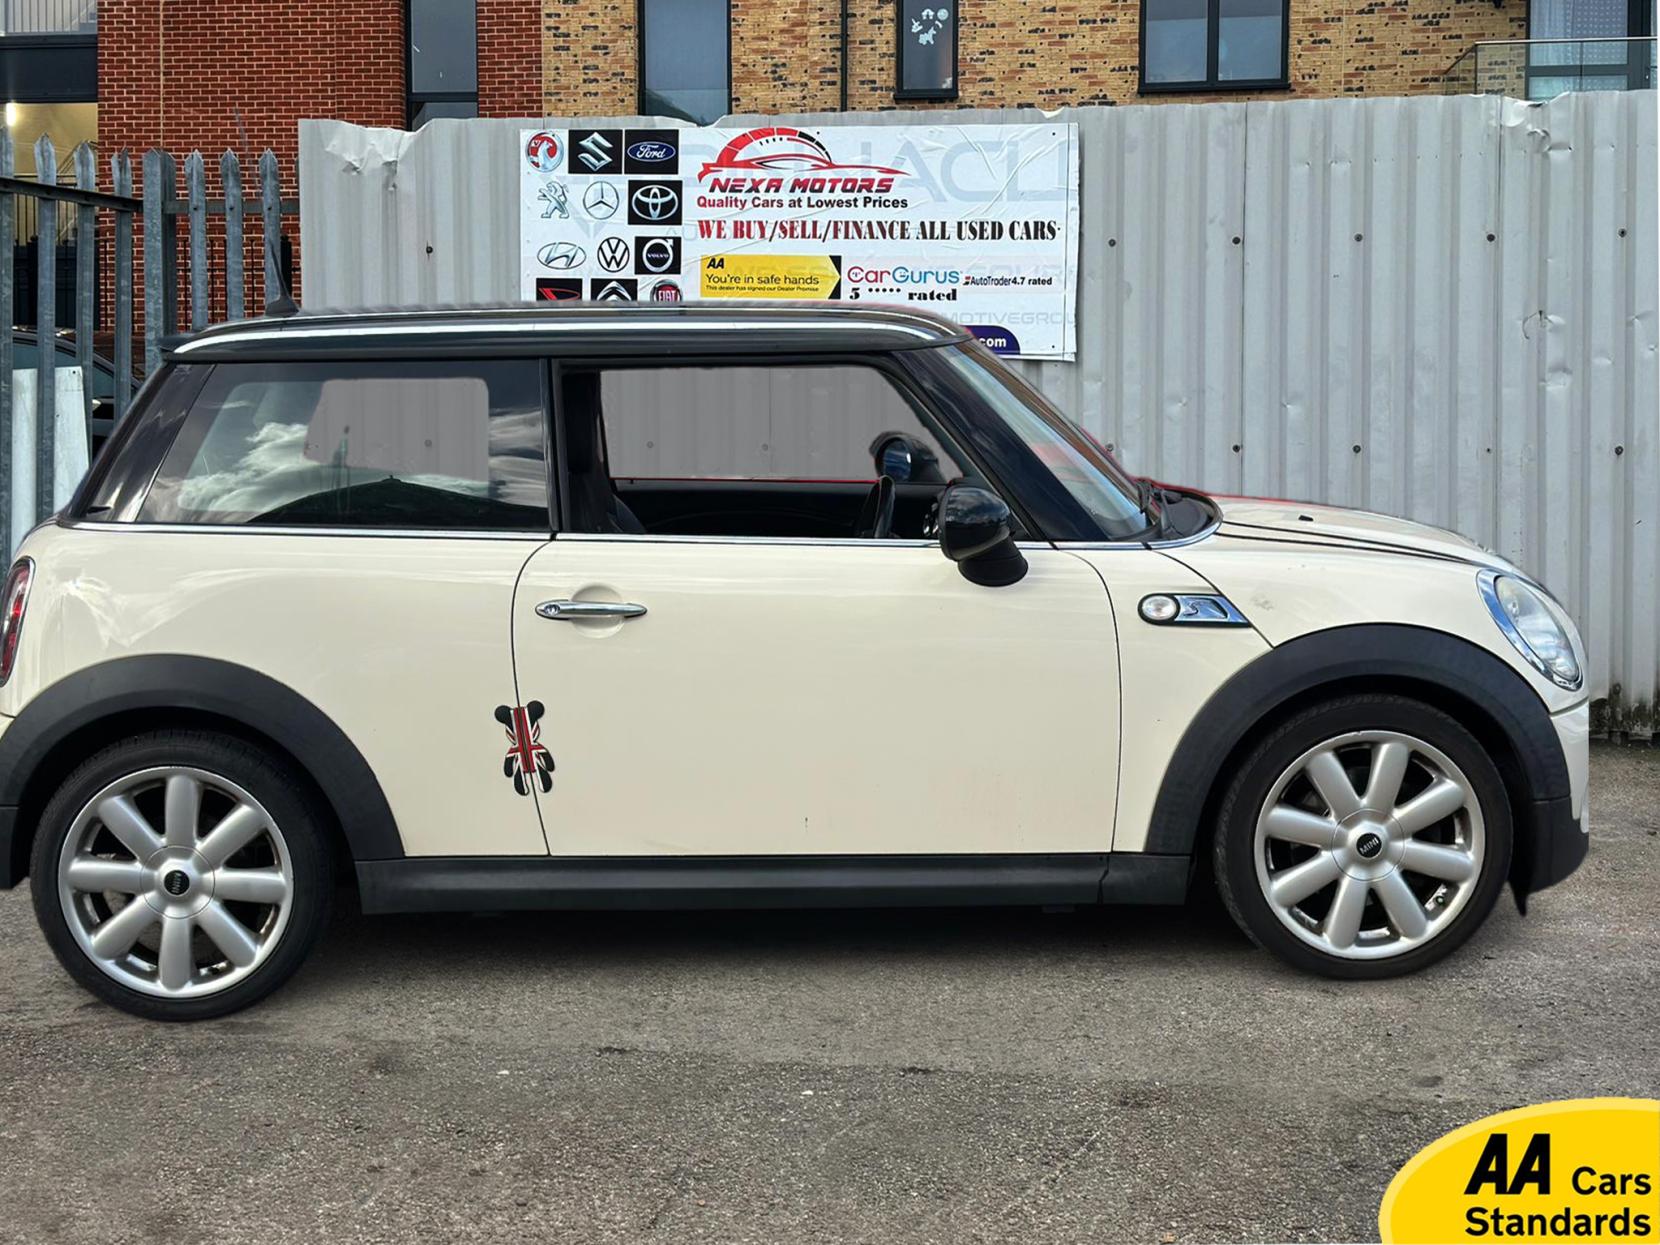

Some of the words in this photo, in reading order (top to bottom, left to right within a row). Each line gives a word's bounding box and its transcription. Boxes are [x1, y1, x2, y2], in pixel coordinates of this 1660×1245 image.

[636, 144, 666, 158] Ford
[709, 178, 783, 193] NEXA
[789, 178, 894, 193] MOTORS
[697, 196, 746, 210] Quality
[752, 196, 783, 208] Cars
[788, 196, 802, 208] at
[807, 196, 859, 208] Lowest
[863, 196, 908, 208] Prices
[698, 220, 726, 240] WE
[916, 220, 950, 240] ALL
[956, 220, 1003, 240] USED
[1008, 220, 1056, 240] CARS
[706, 257, 725, 269] AA
[705, 273, 741, 284] You're
[744, 273, 754, 284] in
[757, 274, 781, 284] safe
[784, 275, 819, 285] hands
[847, 266, 960, 284] CarGurus
[1028, 277, 1052, 286] rated
[849, 287, 860, 300] 5
[908, 288, 957, 301] rated
[1359, 837, 1379, 854] MINI
